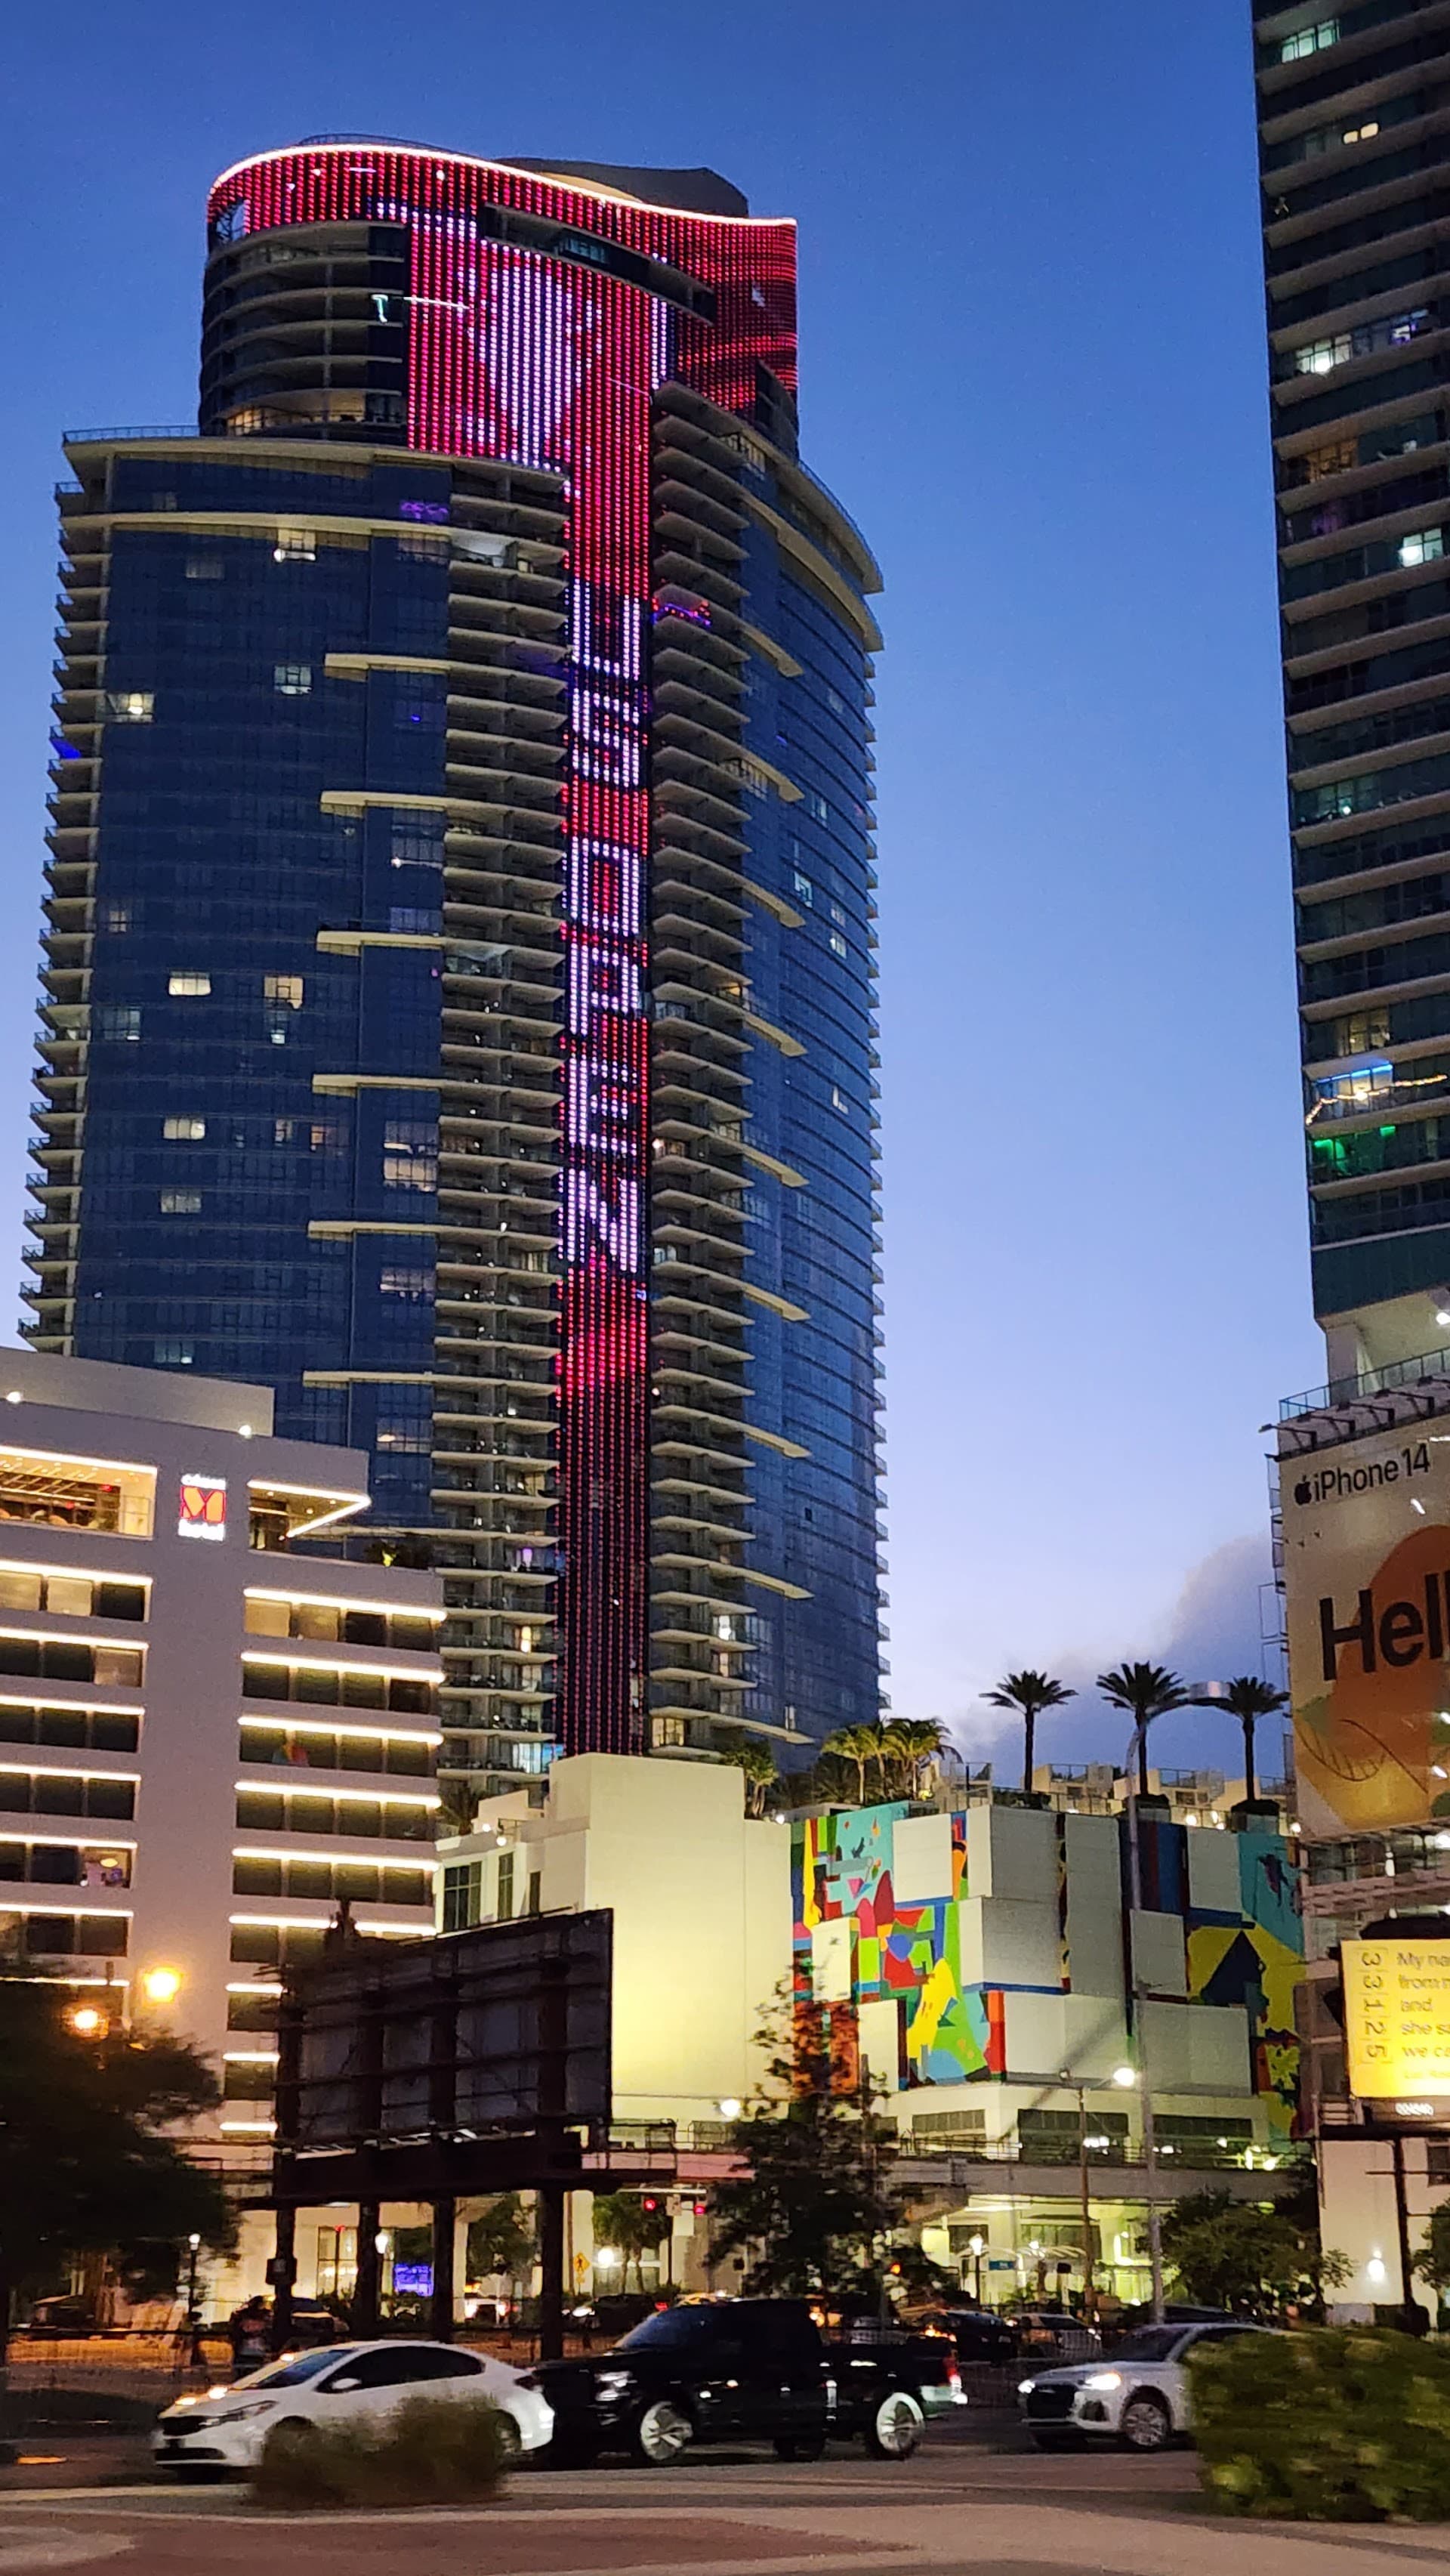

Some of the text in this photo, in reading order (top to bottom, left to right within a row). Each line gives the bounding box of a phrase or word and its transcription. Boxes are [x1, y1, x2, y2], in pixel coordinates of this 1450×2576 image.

[560, 836, 641, 1274] OPEN
[1313, 1443, 1430, 1502] iPhone 14
